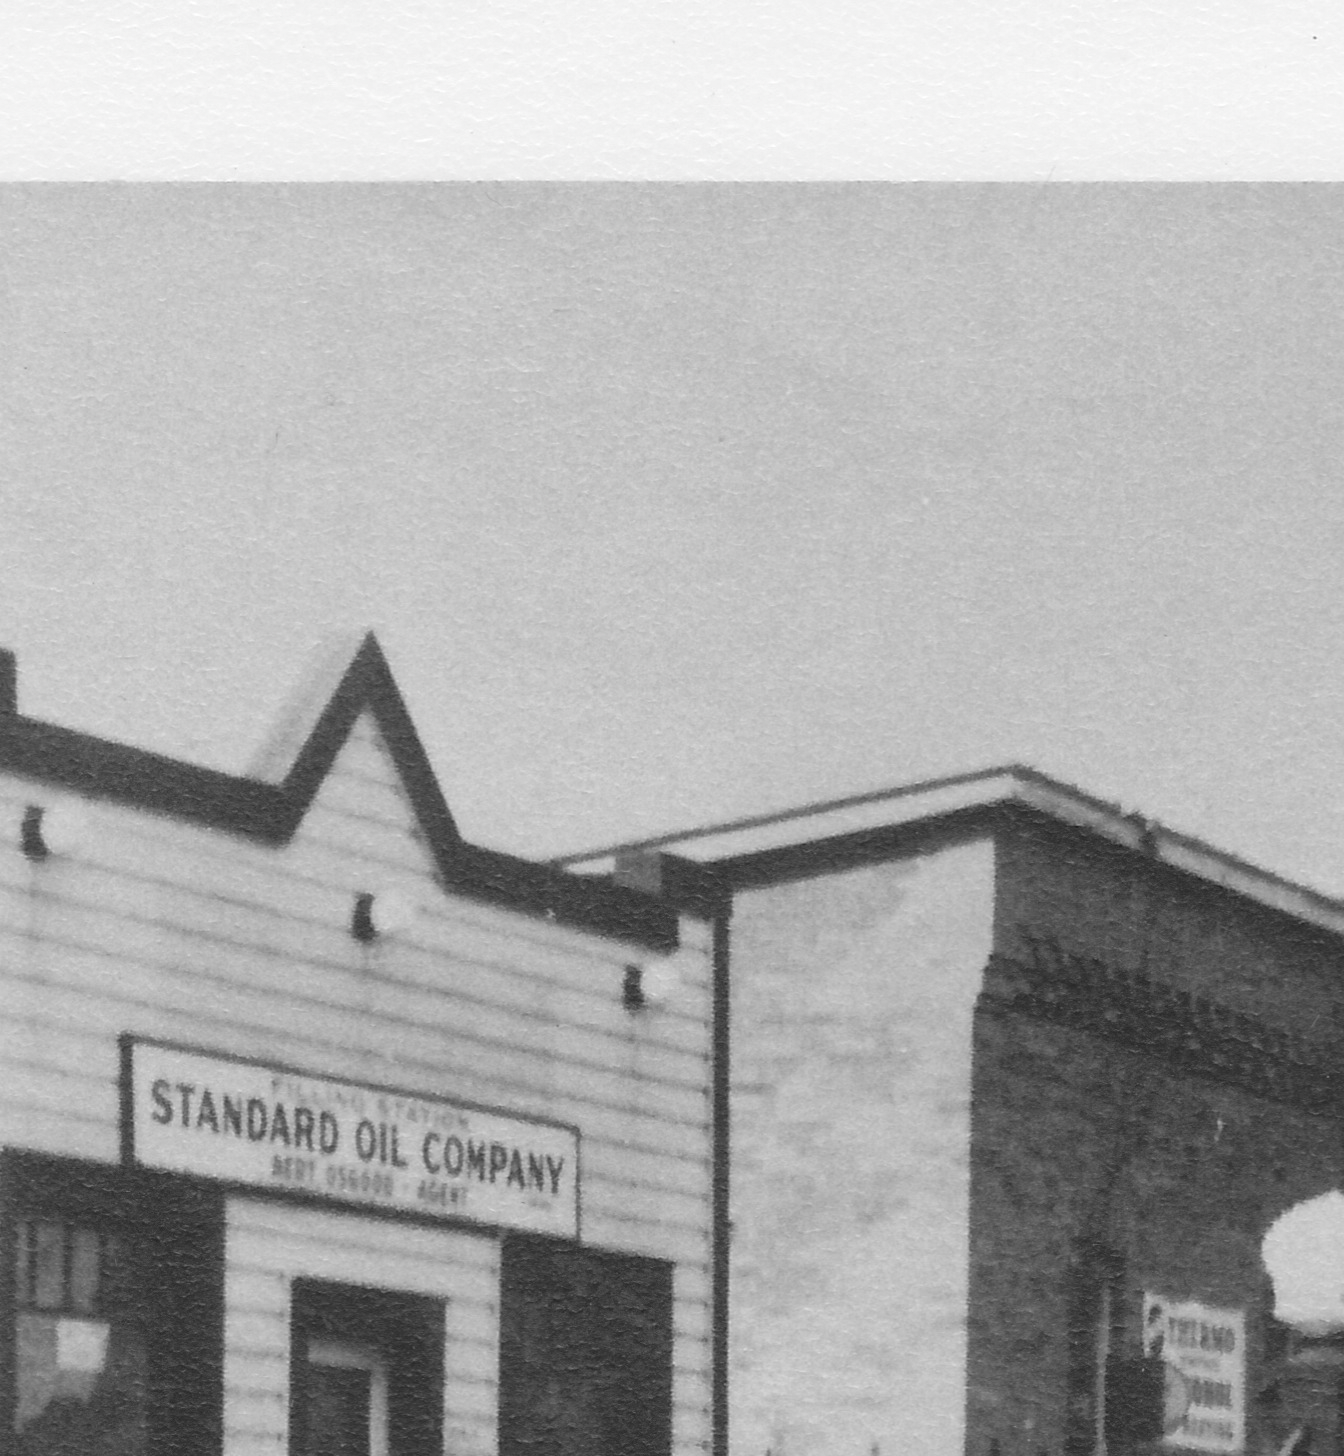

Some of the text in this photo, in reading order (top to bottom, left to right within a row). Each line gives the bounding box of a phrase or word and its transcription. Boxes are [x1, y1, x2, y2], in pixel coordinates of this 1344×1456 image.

[152, 1079, 565, 1194] STANDARD OIL COMPANY
